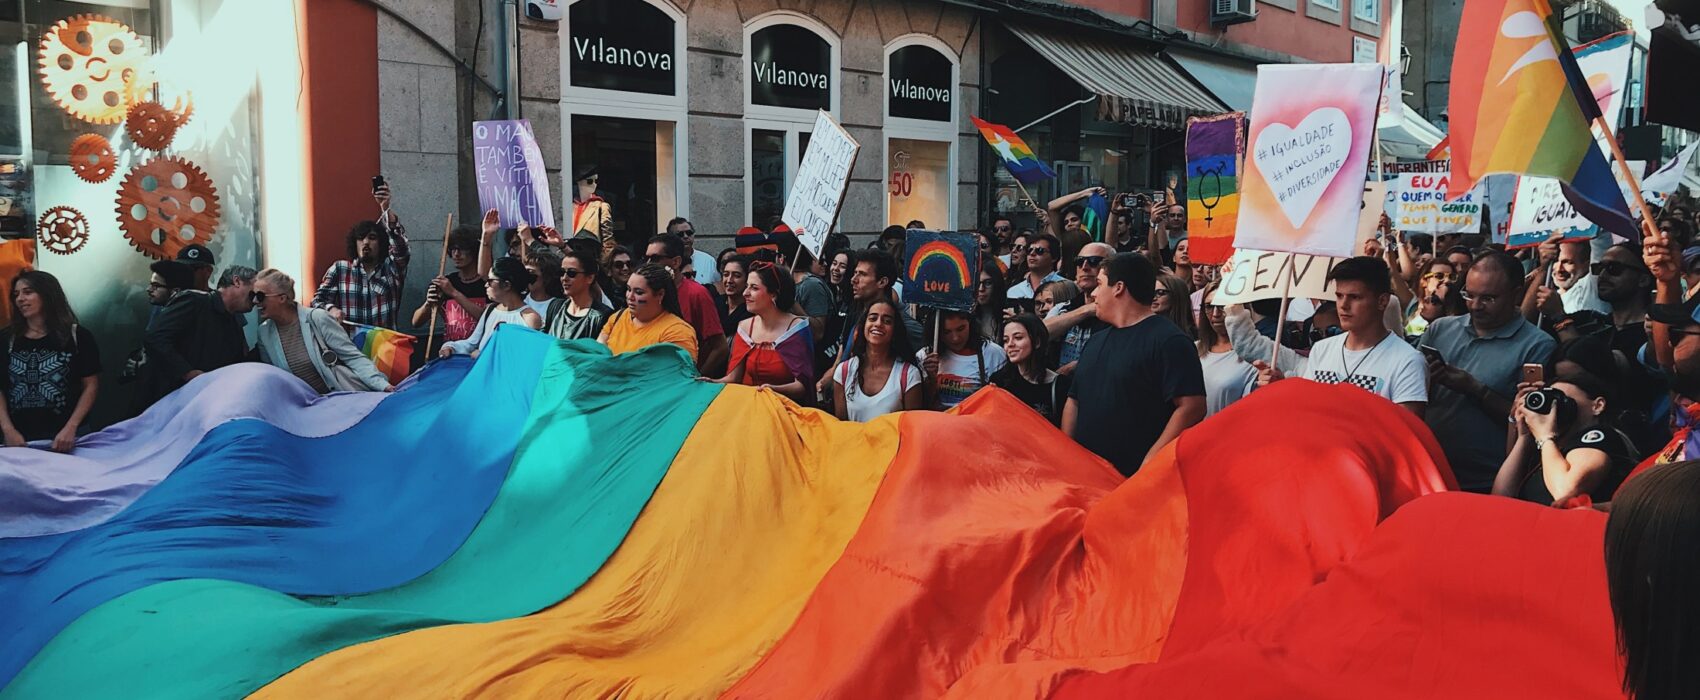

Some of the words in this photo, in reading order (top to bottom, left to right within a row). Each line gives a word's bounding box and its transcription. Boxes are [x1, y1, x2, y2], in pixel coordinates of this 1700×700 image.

[573, 36, 671, 71] Vilanova
[753, 61, 828, 90] Vilanova
[890, 78, 950, 103] Vilanova
[475, 125, 488, 139] O
[479, 162, 488, 184] É
[1279, 159, 1341, 202] #DIVERSIDADE
[1411, 176, 1433, 188] EU
[1401, 192, 1432, 202] QUEM
[791, 195, 806, 224] EU
[1402, 216, 1428, 225] QUE
[924, 279, 950, 293] LOVE
